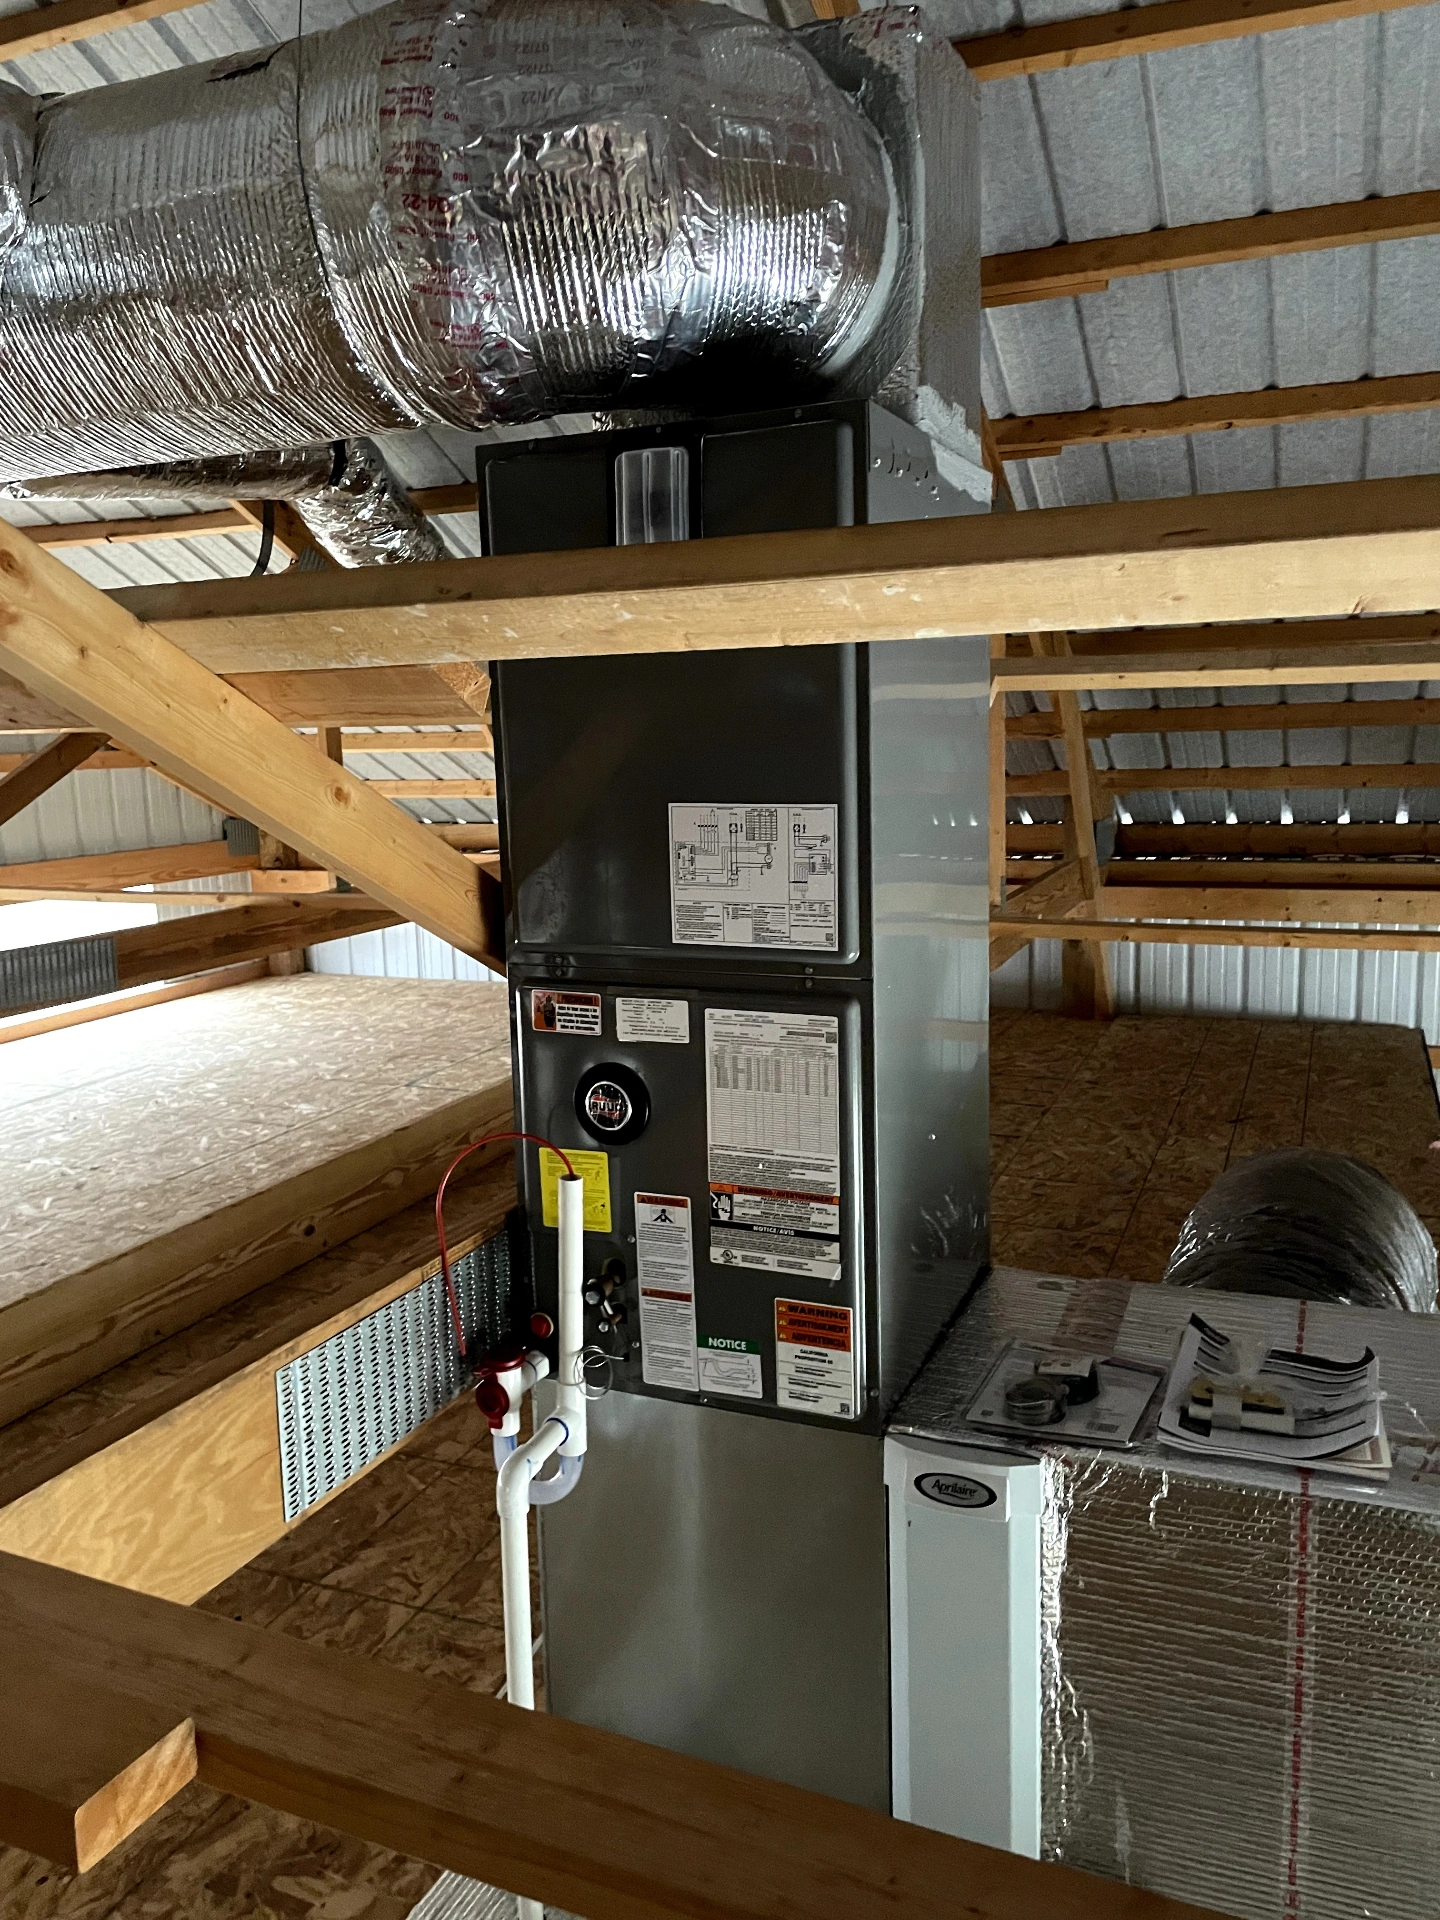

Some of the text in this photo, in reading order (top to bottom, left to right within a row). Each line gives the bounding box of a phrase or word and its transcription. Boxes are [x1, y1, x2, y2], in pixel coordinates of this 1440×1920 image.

[591, 1101, 623, 1112] RUUD
[788, 1304, 848, 1321] WARNING
[708, 1337, 747, 1350] NOTICE
[932, 1479, 979, 1497] Aprilaire
